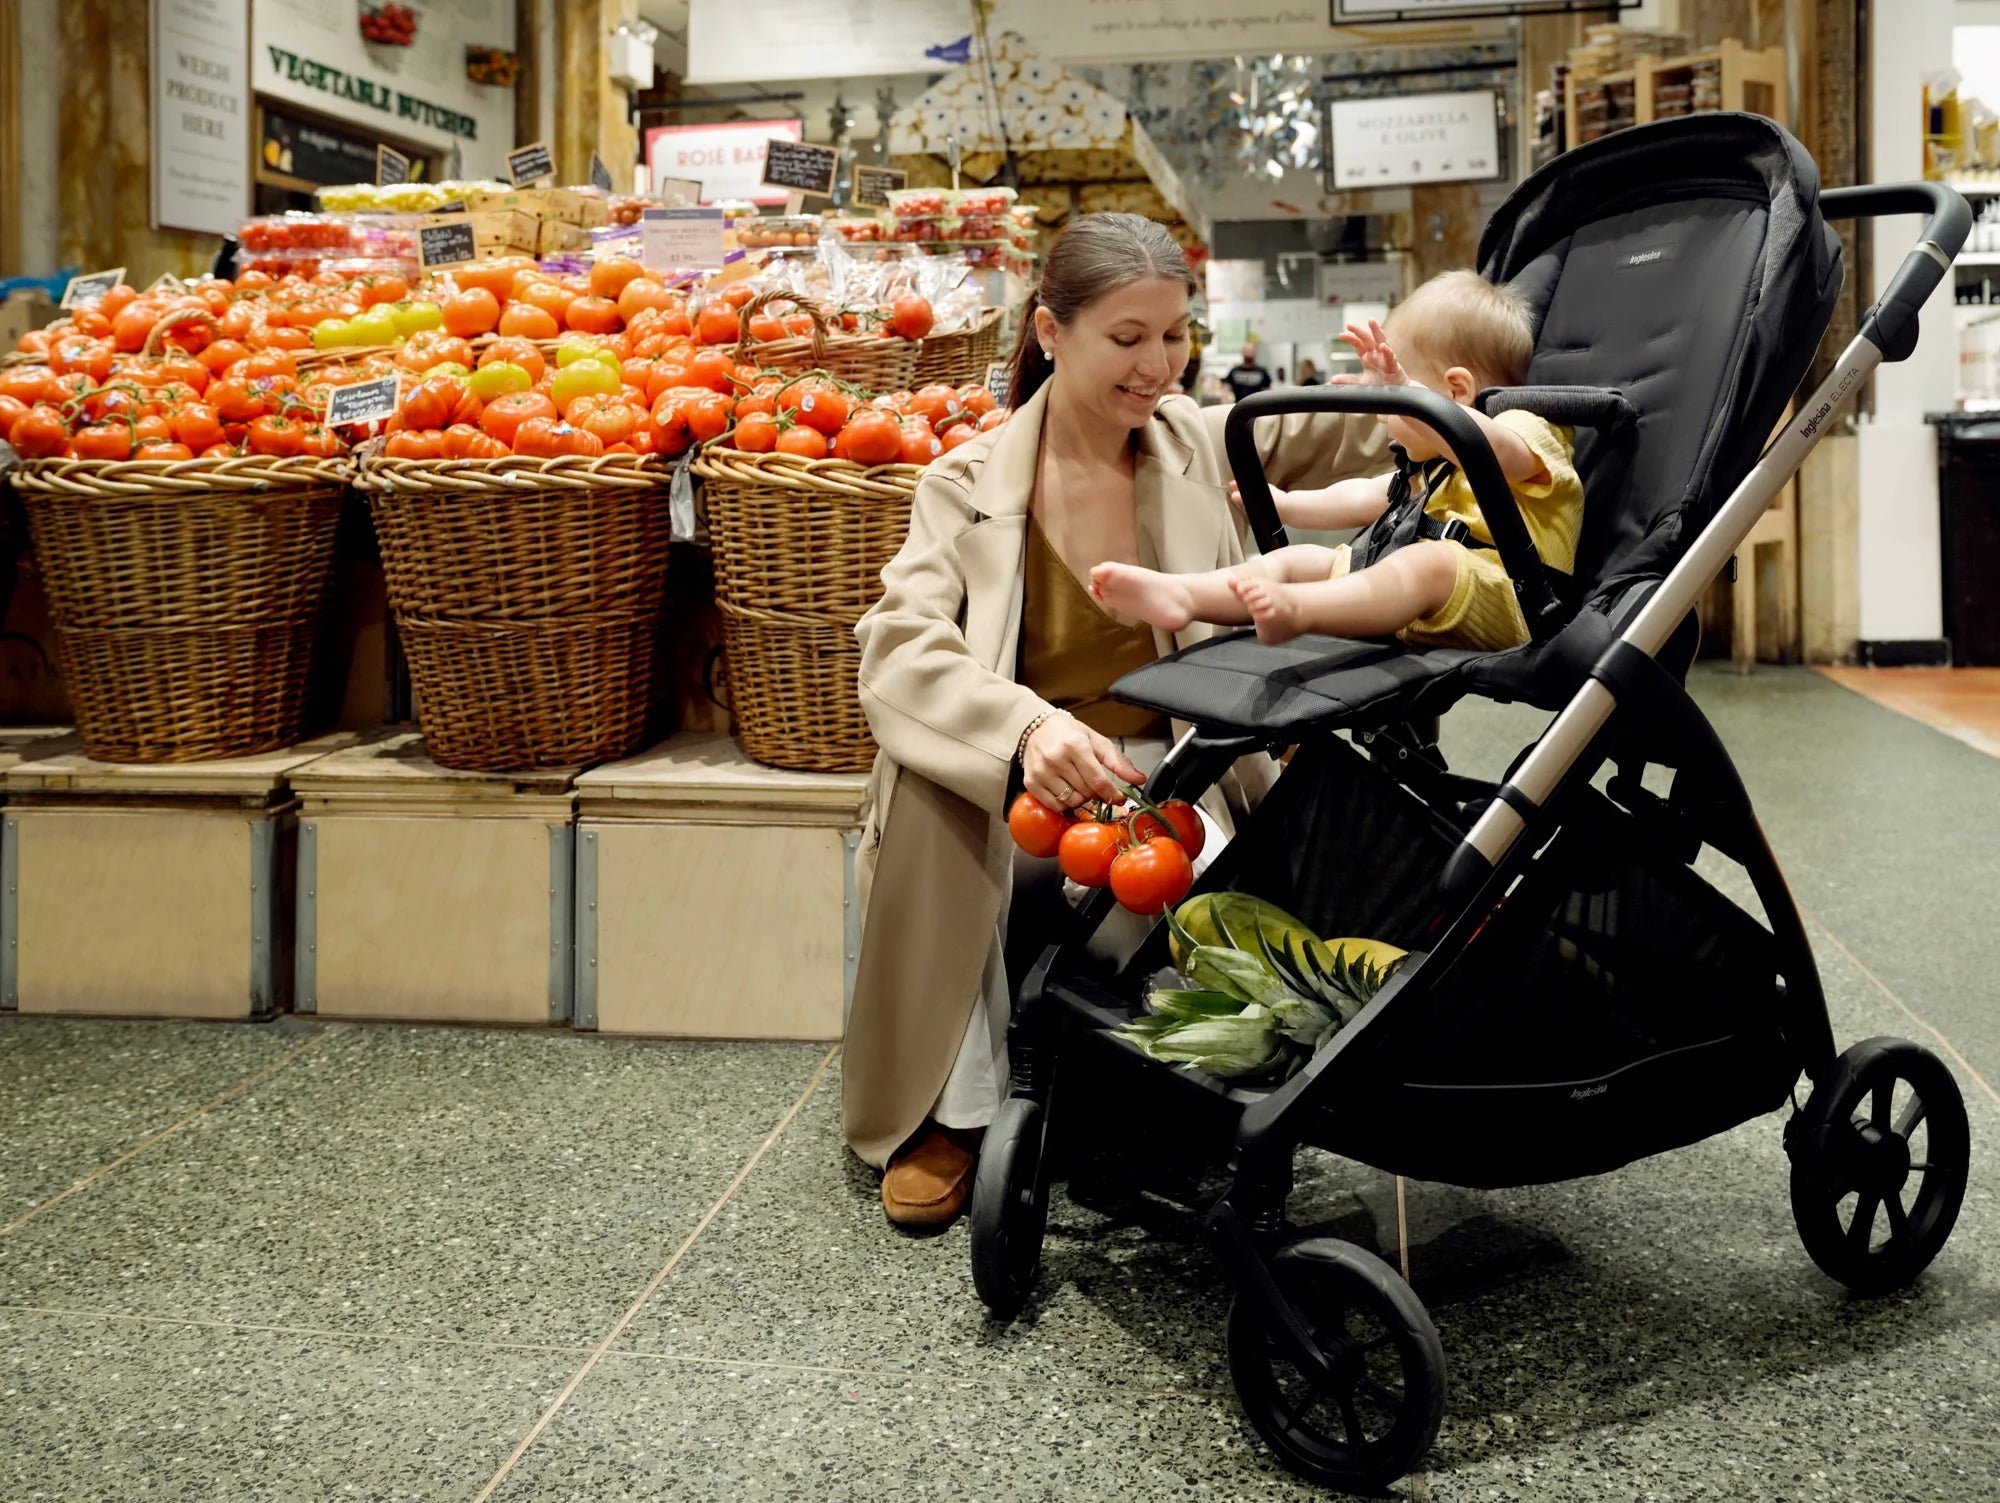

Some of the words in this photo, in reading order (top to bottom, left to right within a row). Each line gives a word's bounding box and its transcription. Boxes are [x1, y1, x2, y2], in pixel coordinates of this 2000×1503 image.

[166, 78, 239, 116] PRODUCE
[268, 45, 391, 112] VEGETABLE
[397, 91, 478, 141] BUTCHER
[181, 111, 225, 141] HERE
[1358, 111, 1470, 130] MOZZARELLA
[1395, 128, 1447, 144] OLIVE
[1800, 402, 1832, 438] Inglesina
[1830, 367, 1860, 402] ELECTA
